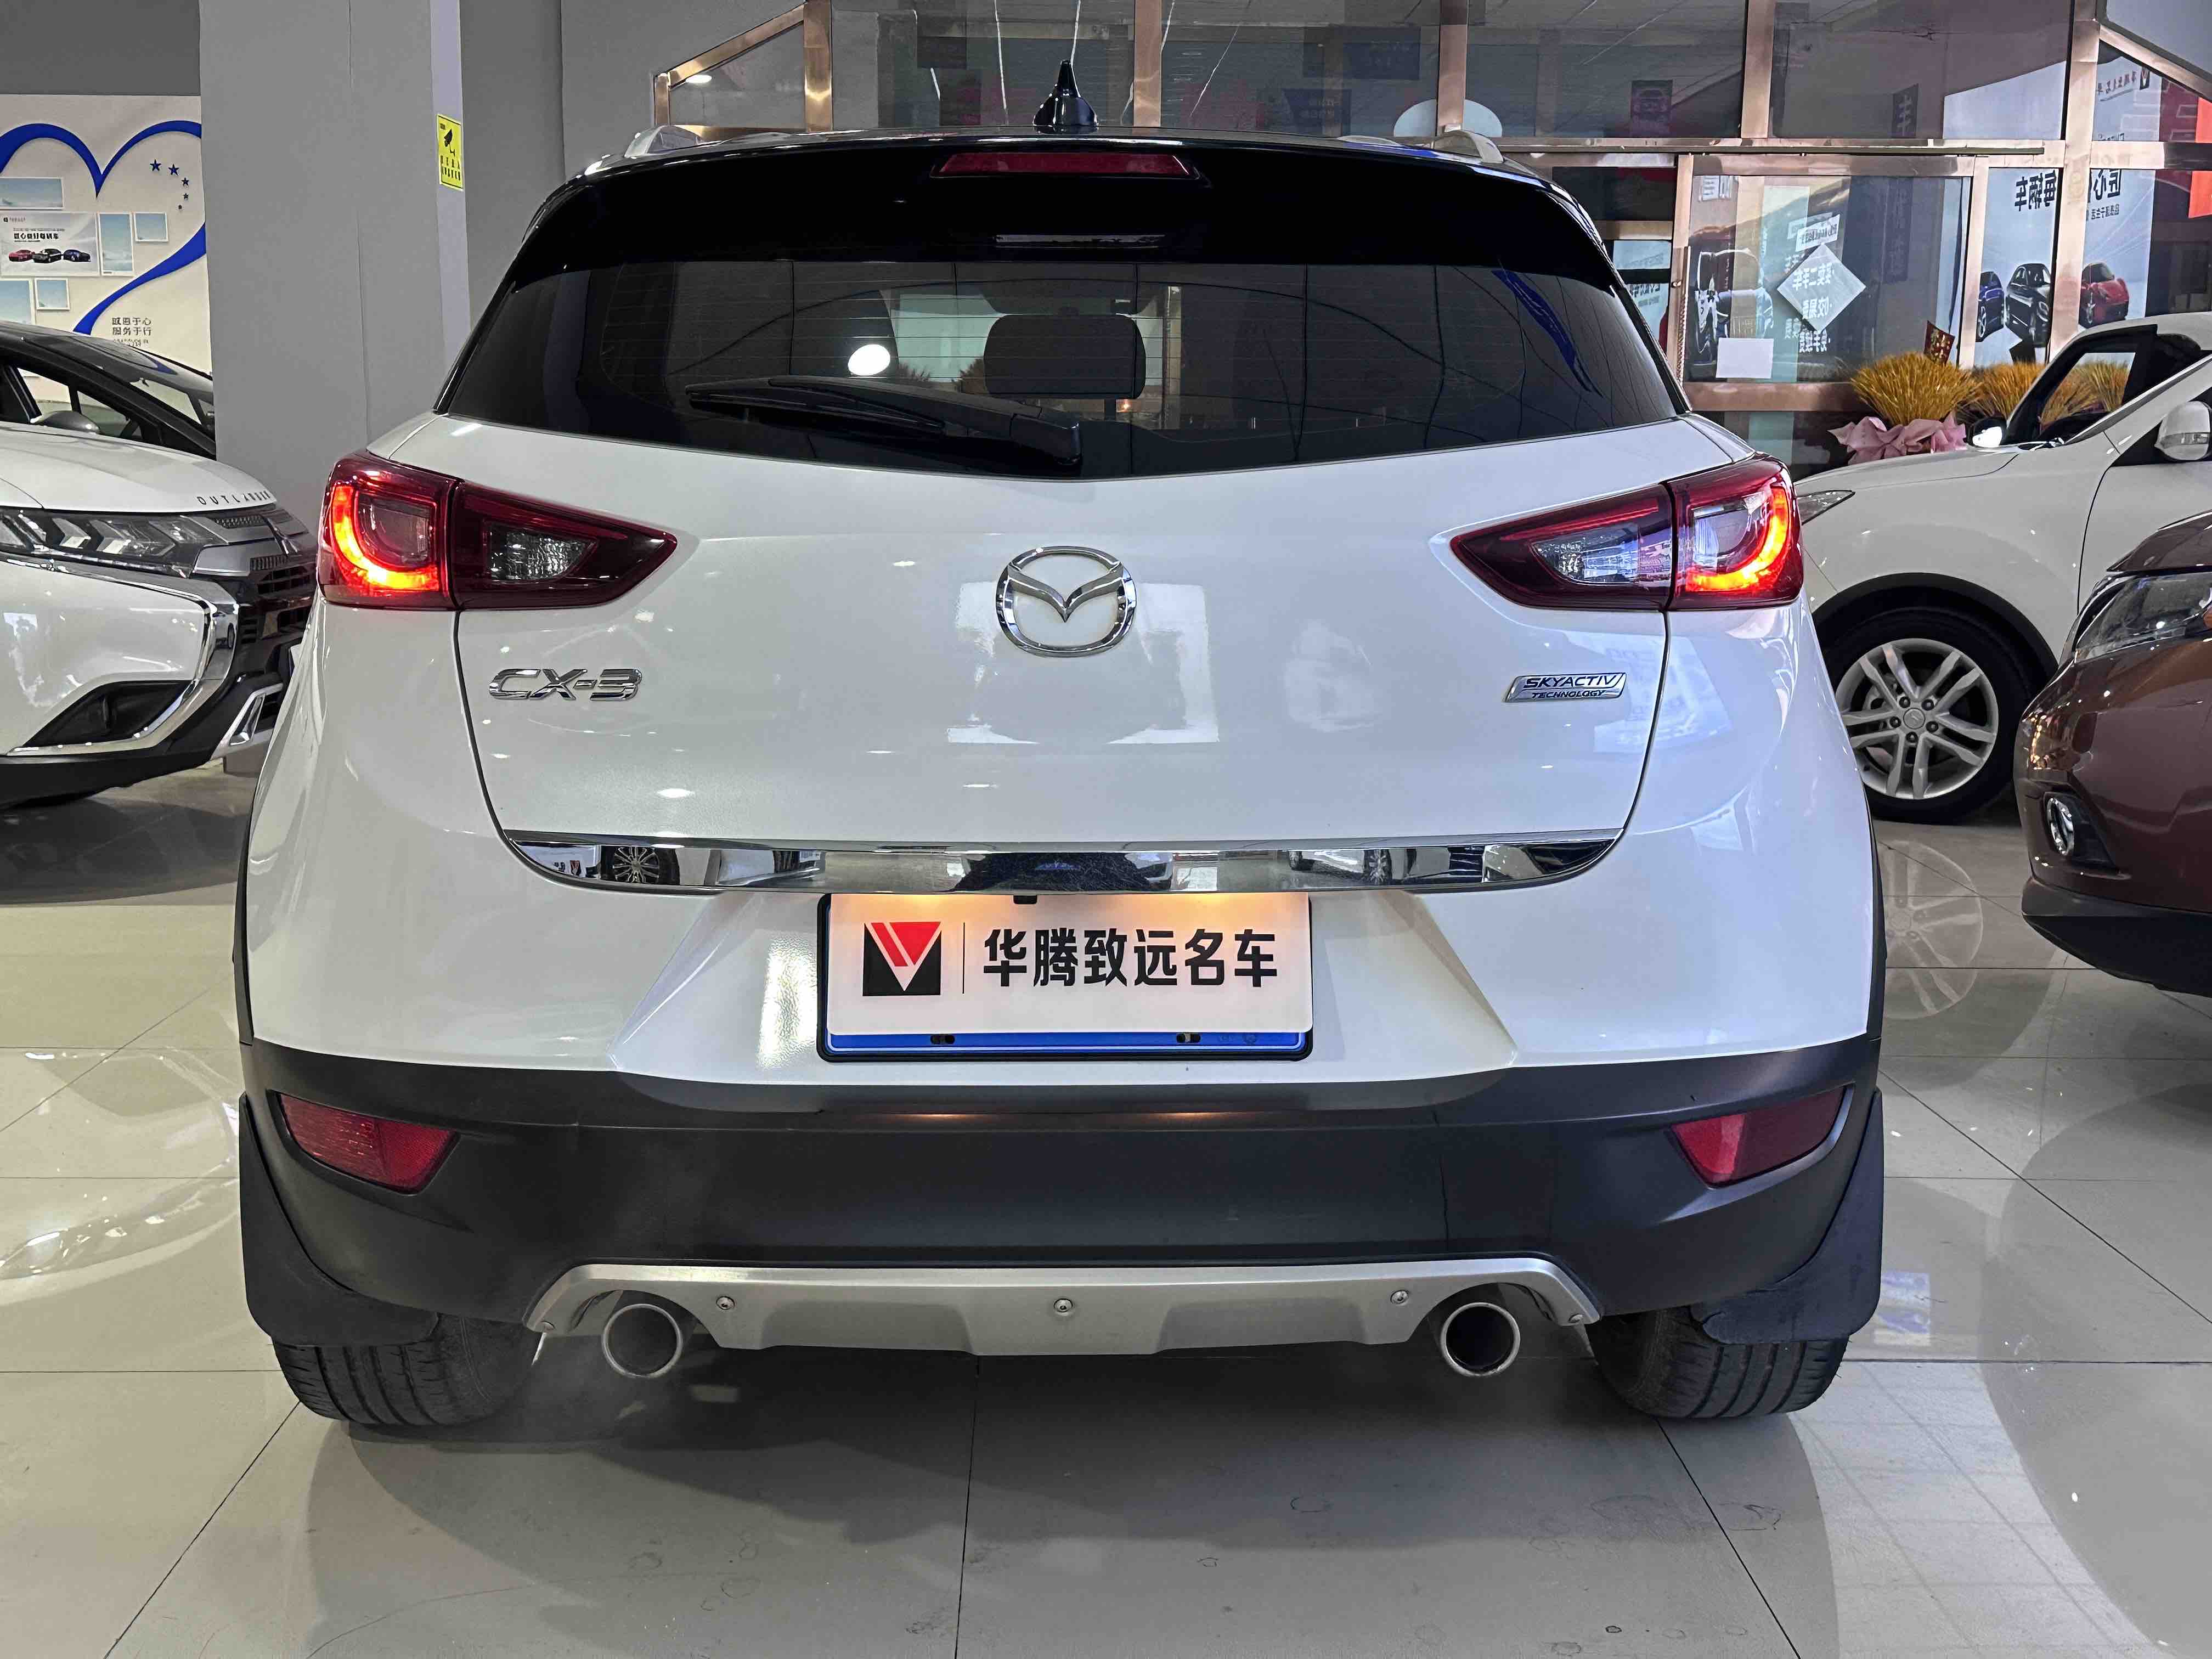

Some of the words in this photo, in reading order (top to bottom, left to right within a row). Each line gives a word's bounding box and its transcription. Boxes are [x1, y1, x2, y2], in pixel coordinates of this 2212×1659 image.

[488, 668, 642, 701] CX-3
[1523, 675, 1617, 689] SKYACTIV
[1531, 690, 1607, 699] TECHNOLOGY
[983, 927, 1279, 988] 华腾致远名车
